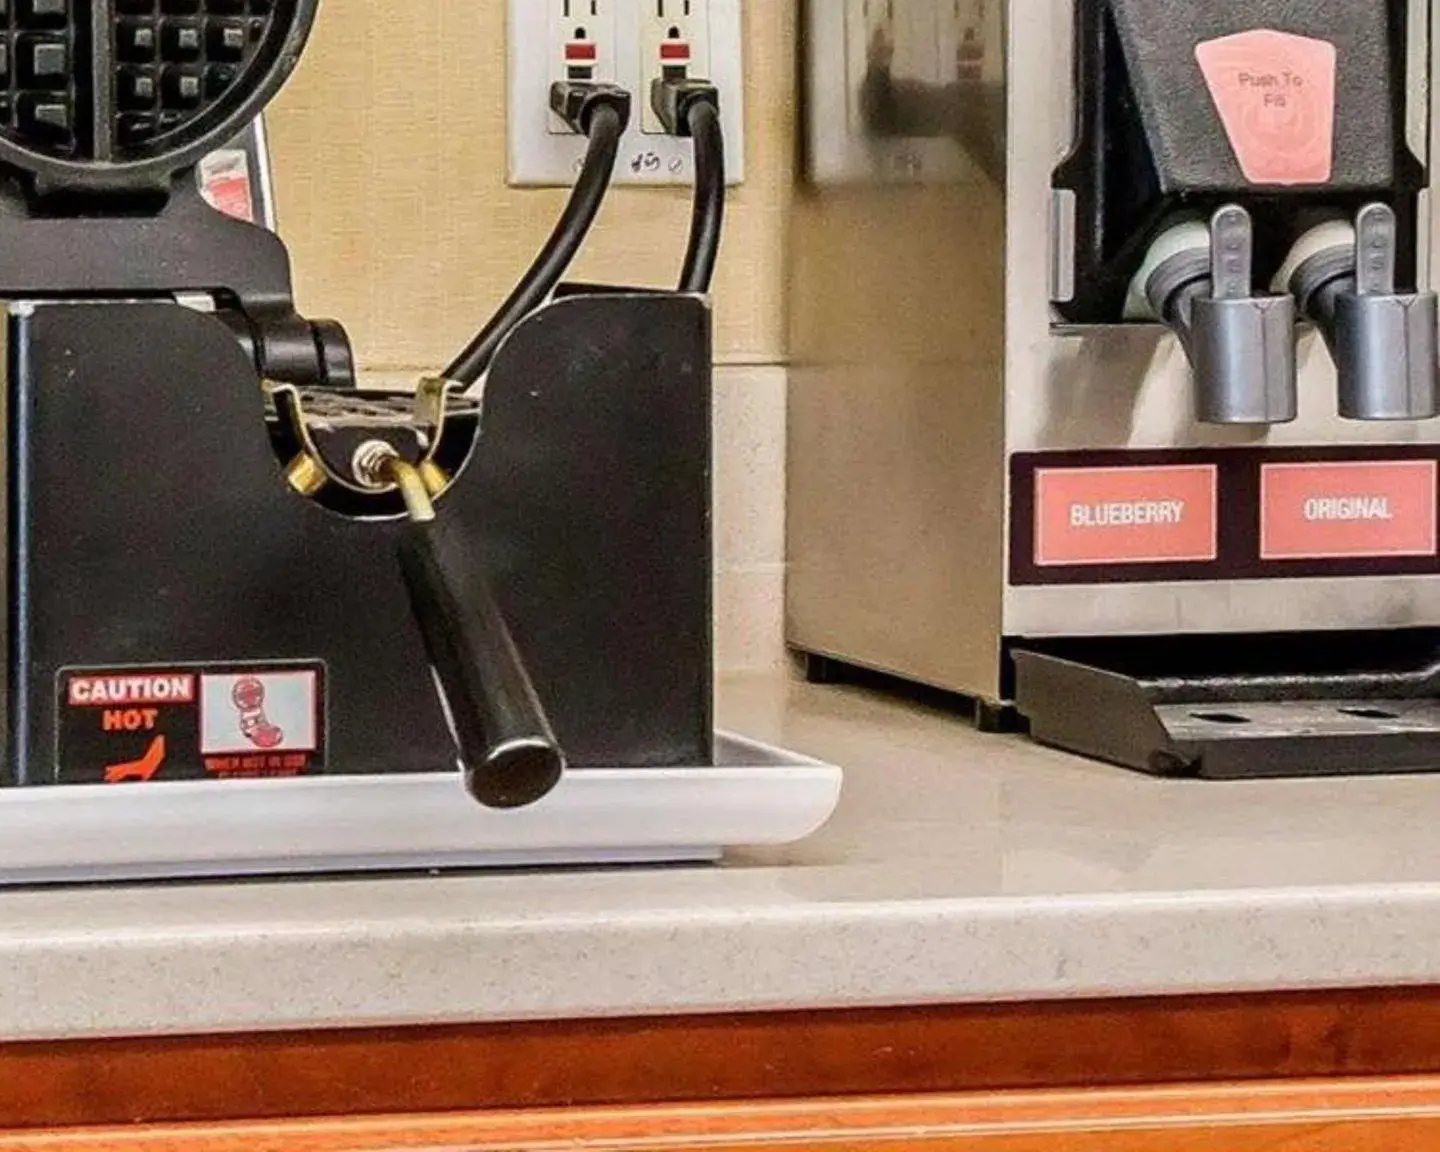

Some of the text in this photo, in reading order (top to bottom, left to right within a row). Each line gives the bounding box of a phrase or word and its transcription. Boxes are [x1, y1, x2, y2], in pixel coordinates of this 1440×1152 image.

[1238, 71, 1304, 88] Push To
[1069, 500, 1187, 528] BLUEBERRY
[1303, 497, 1394, 522] ORIGINAL
[71, 676, 190, 700] CAUTION
[103, 709, 158, 730] HOT
